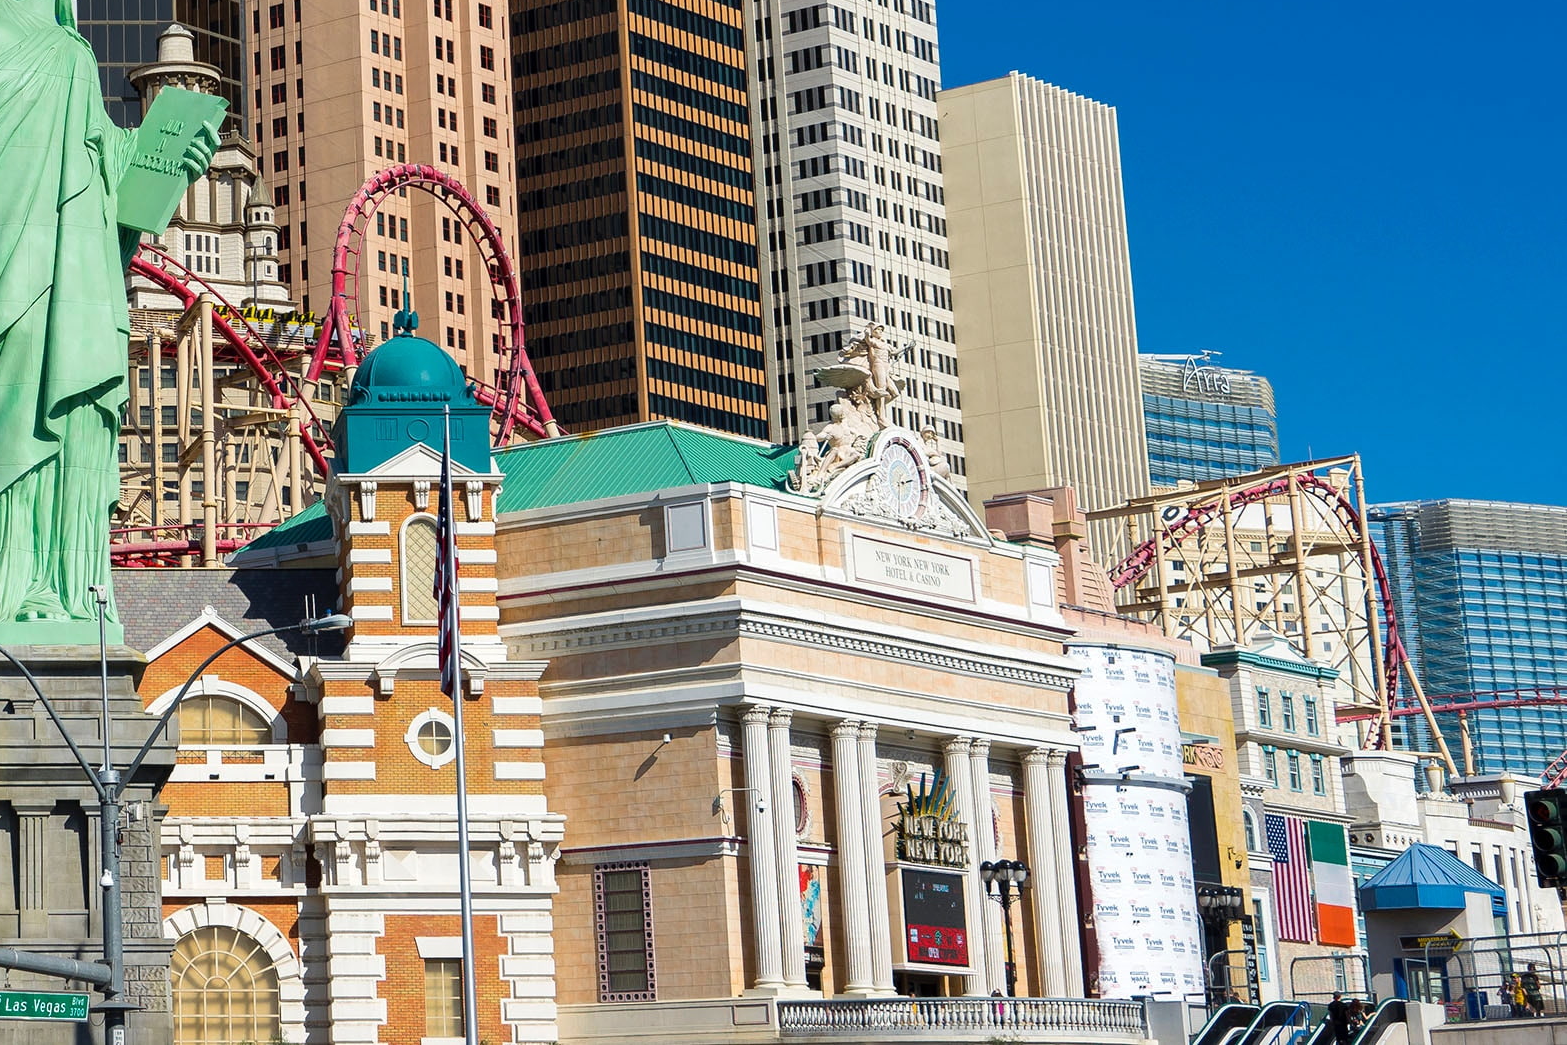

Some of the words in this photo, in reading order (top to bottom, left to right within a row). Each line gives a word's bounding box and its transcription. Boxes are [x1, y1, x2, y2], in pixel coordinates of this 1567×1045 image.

[875, 550, 892, 562] NEW
[894, 555, 912, 568] YORK
[914, 558, 931, 571] NEW
[932, 562, 950, 576] YORK
[886, 566, 908, 580] HOTEL
[916, 573, 941, 587] CASINO
[1105, 703, 1124, 711] Tyvek
[1120, 802, 1138, 810] Tyvek
[905, 816, 936, 837] NEW
[937, 820, 970, 842] YORK
[906, 839, 938, 860] NEW
[939, 843, 971, 865] YORK
[1145, 938, 1162, 946] Tyvek
[5, 998, 27, 1012] Las
[34, 999, 66, 1016] Vegas
[72, 997, 84, 1006] Blvd
[70, 1008, 84, 1017] 3700
